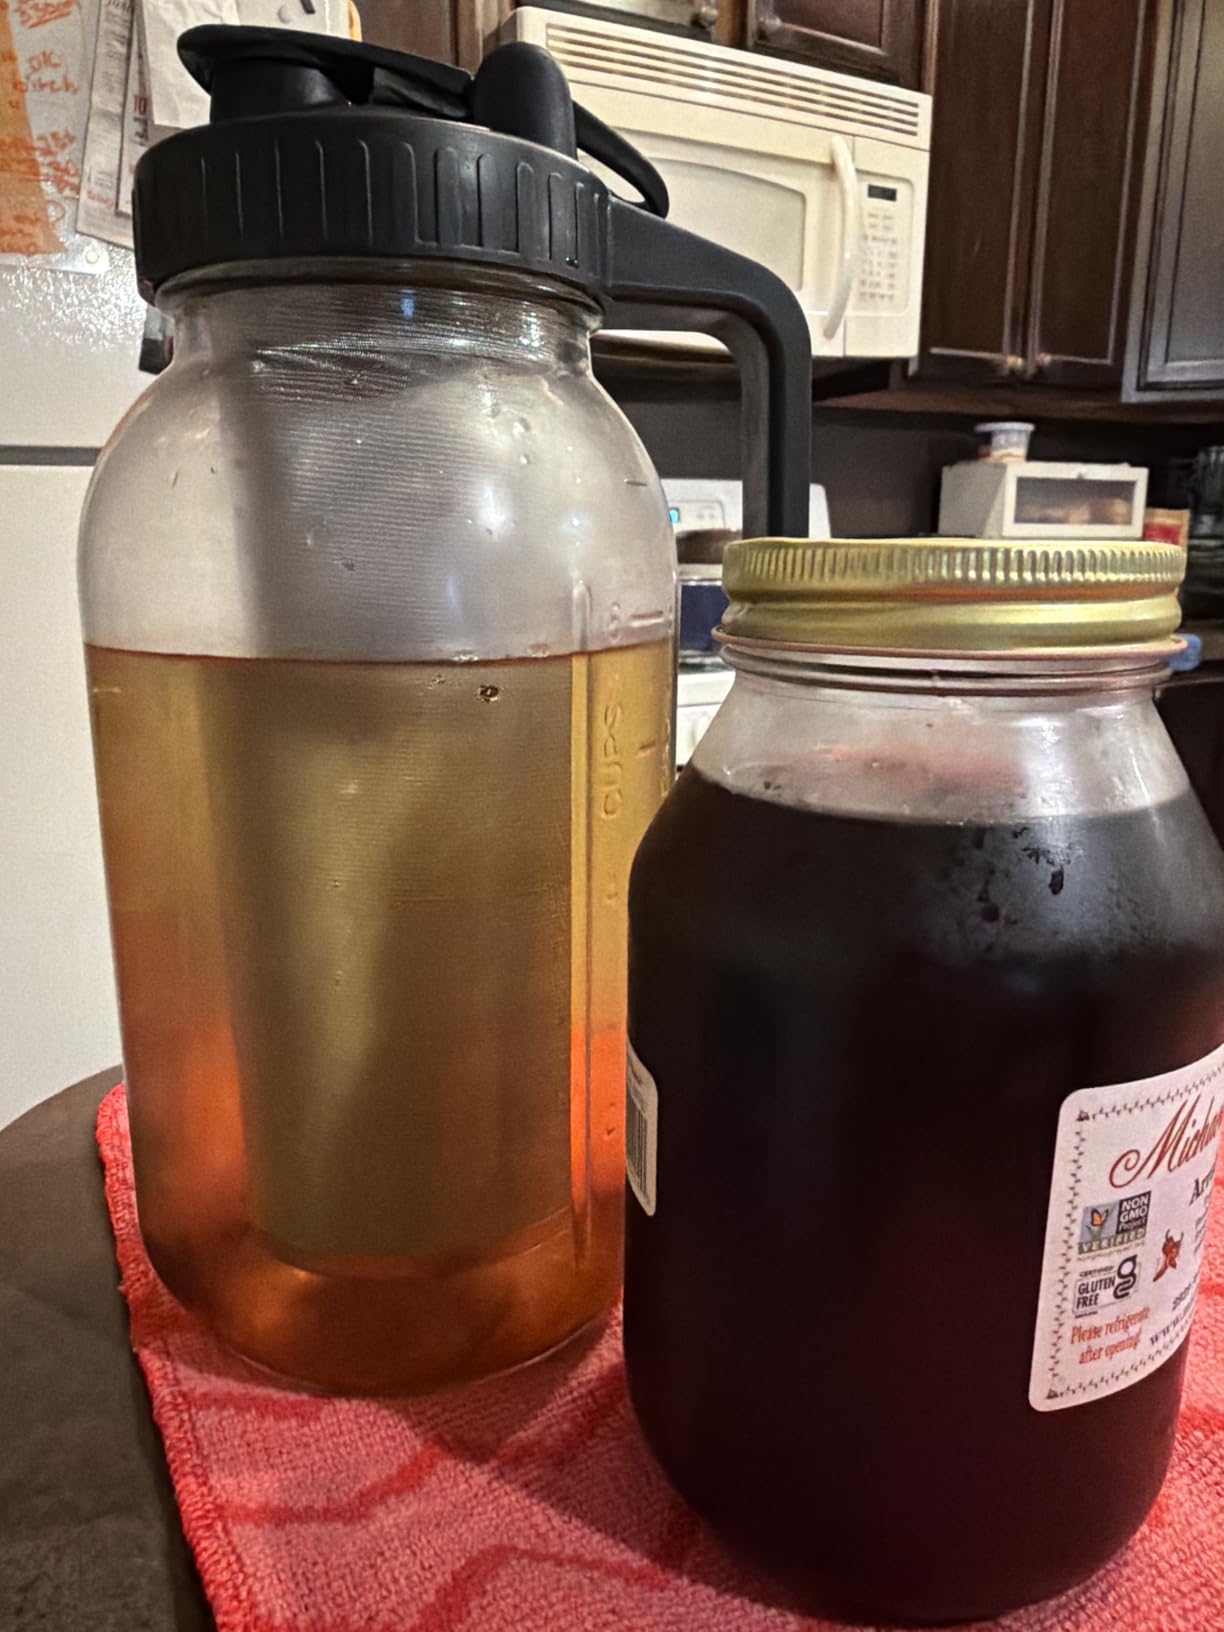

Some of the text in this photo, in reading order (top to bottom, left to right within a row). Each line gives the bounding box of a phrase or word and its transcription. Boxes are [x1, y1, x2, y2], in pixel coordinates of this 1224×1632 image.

[1121, 1195, 1149, 1212] NON
[1120, 1206, 1147, 1223] GMO
[1078, 1276, 1116, 1295] GLUTEN
[1076, 1293, 1099, 1310] FREE
[1070, 1326, 1103, 1345] Please
[1079, 1345, 1103, 1364] after
